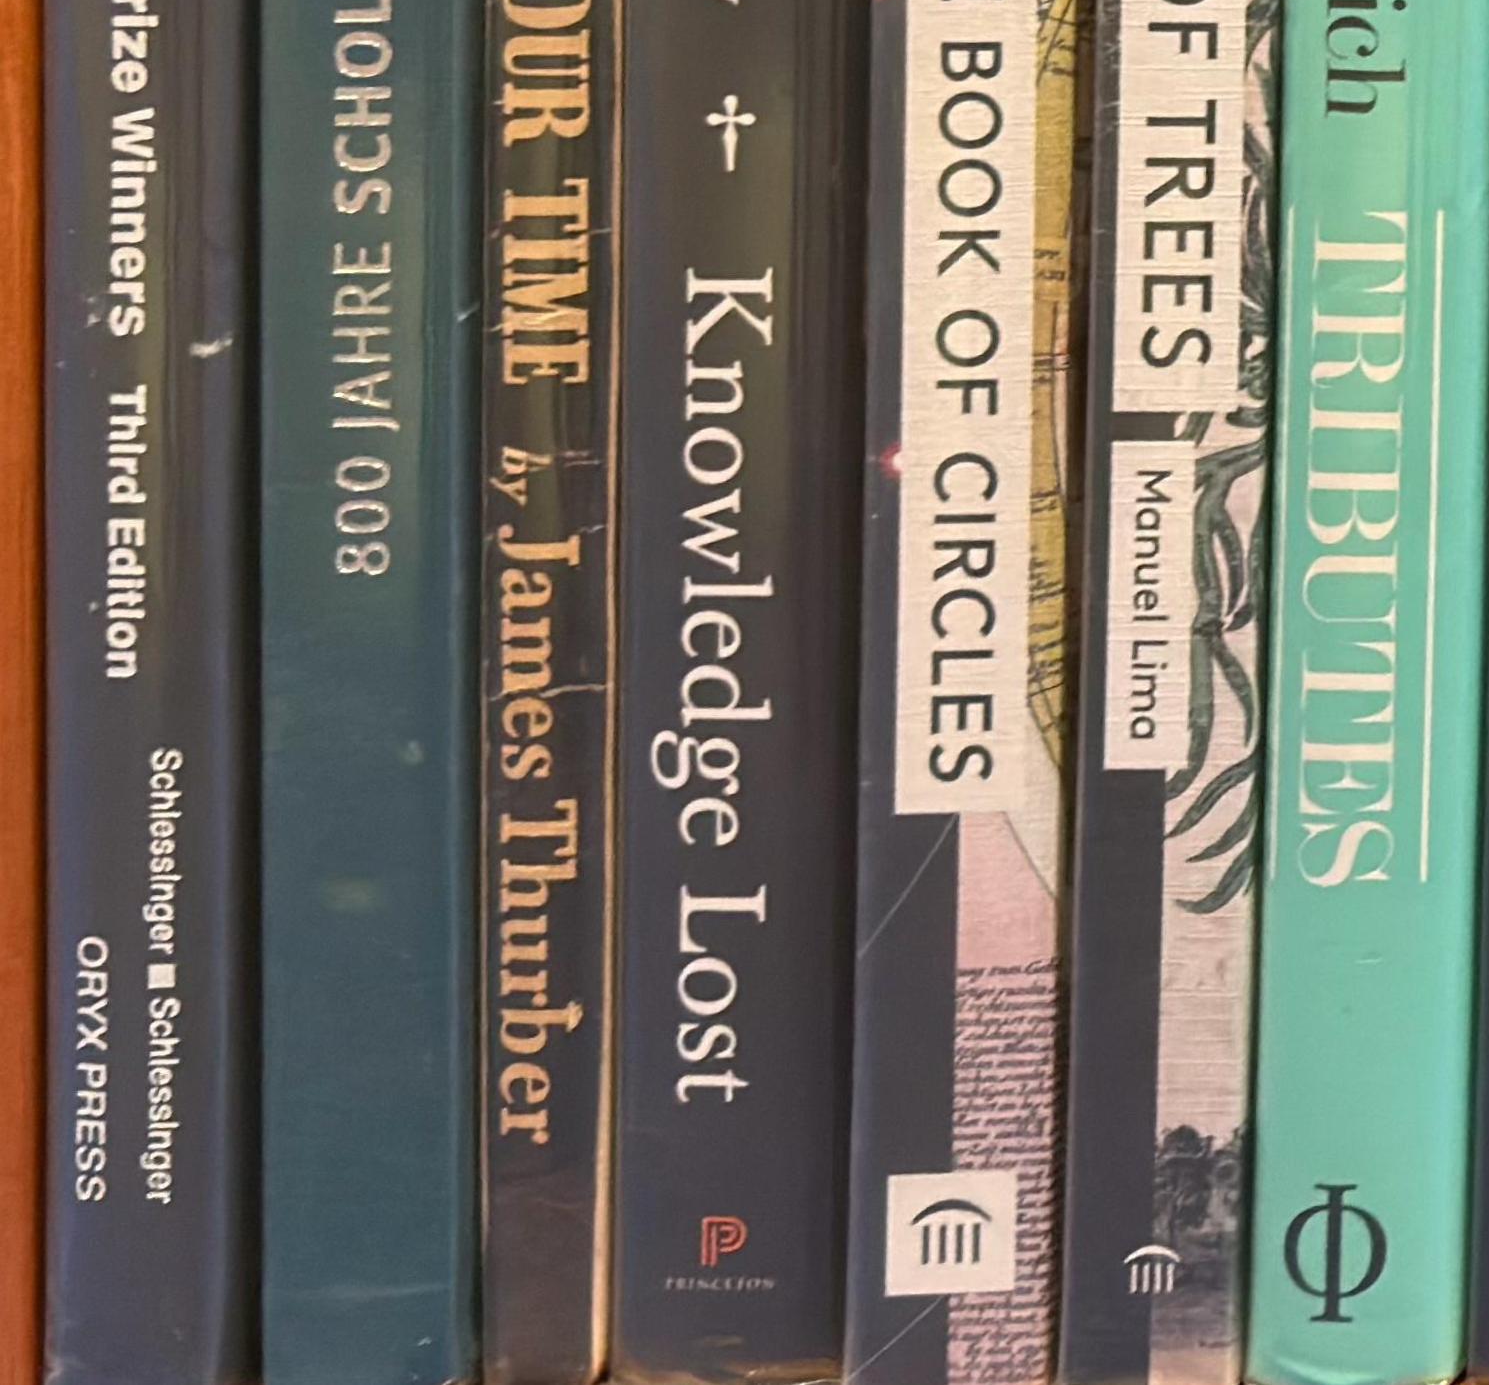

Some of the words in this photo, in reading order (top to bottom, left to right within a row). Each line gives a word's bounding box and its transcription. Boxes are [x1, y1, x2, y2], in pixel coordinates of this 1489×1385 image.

[108, 107, 157, 337] Winners
[937, 40, 1002, 275] BOOK
[1141, 99, 1217, 371] TREES
[334, 241, 398, 431] JAHRE
[502, 178, 591, 385] TIME
[935, 310, 1000, 418] OF
[107, 385, 147, 507] Third
[335, 457, 391, 577] 800
[491, 447, 553, 505] by
[1132, 470, 1172, 629] Manuel
[105, 519, 143, 679] Edition
[650, 267, 776, 846] Knowledge
[928, 451, 998, 785] CIRCLES
[1298, 210, 1408, 890] TRIBUTES
[497, 527, 581, 782] James
[1130, 638, 1169, 742] Lima
[145, 747, 182, 954] Schlessinger
[78, 935, 109, 1049] ORYX
[497, 799, 580, 1146] Thurber
[675, 883, 767, 1104] Lost
[75, 1063, 106, 1202] PRESS
[141, 998, 178, 1205] Schlessinger
